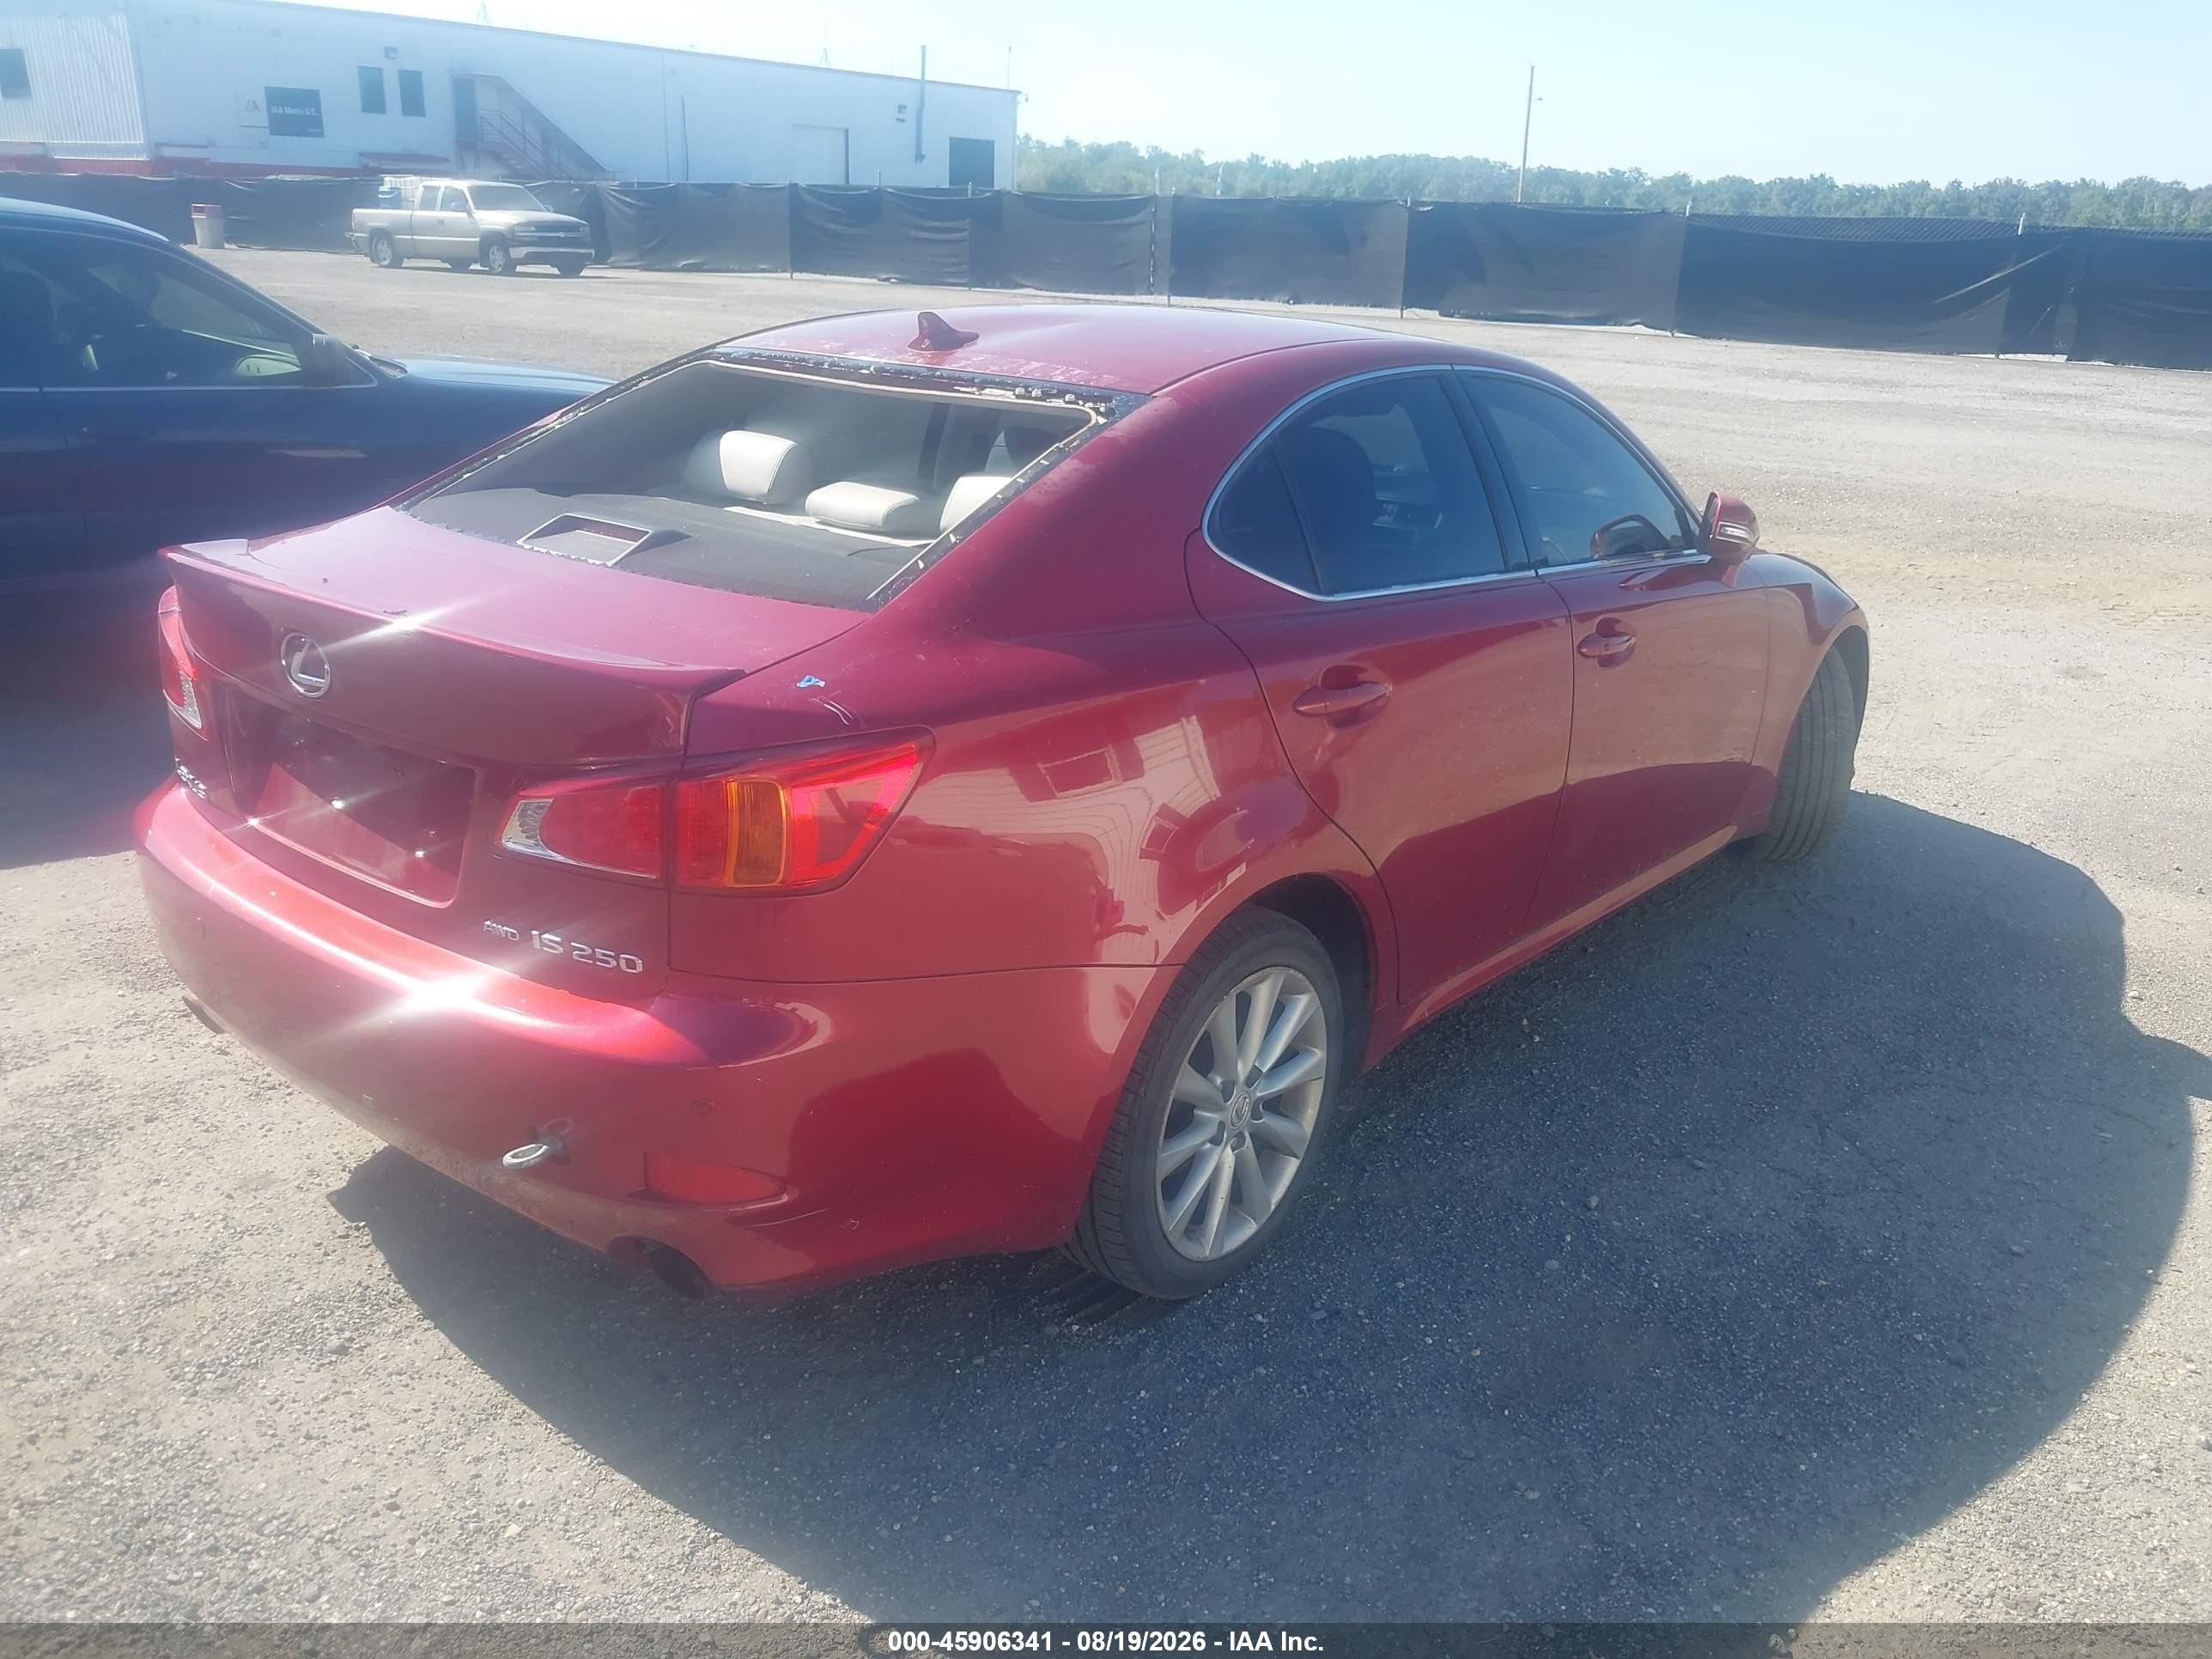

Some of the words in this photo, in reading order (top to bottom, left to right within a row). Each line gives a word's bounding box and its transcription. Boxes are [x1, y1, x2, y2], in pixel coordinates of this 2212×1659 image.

[483, 920, 520, 941] AWD
[531, 930, 564, 955] IS
[569, 941, 644, 974] 250
